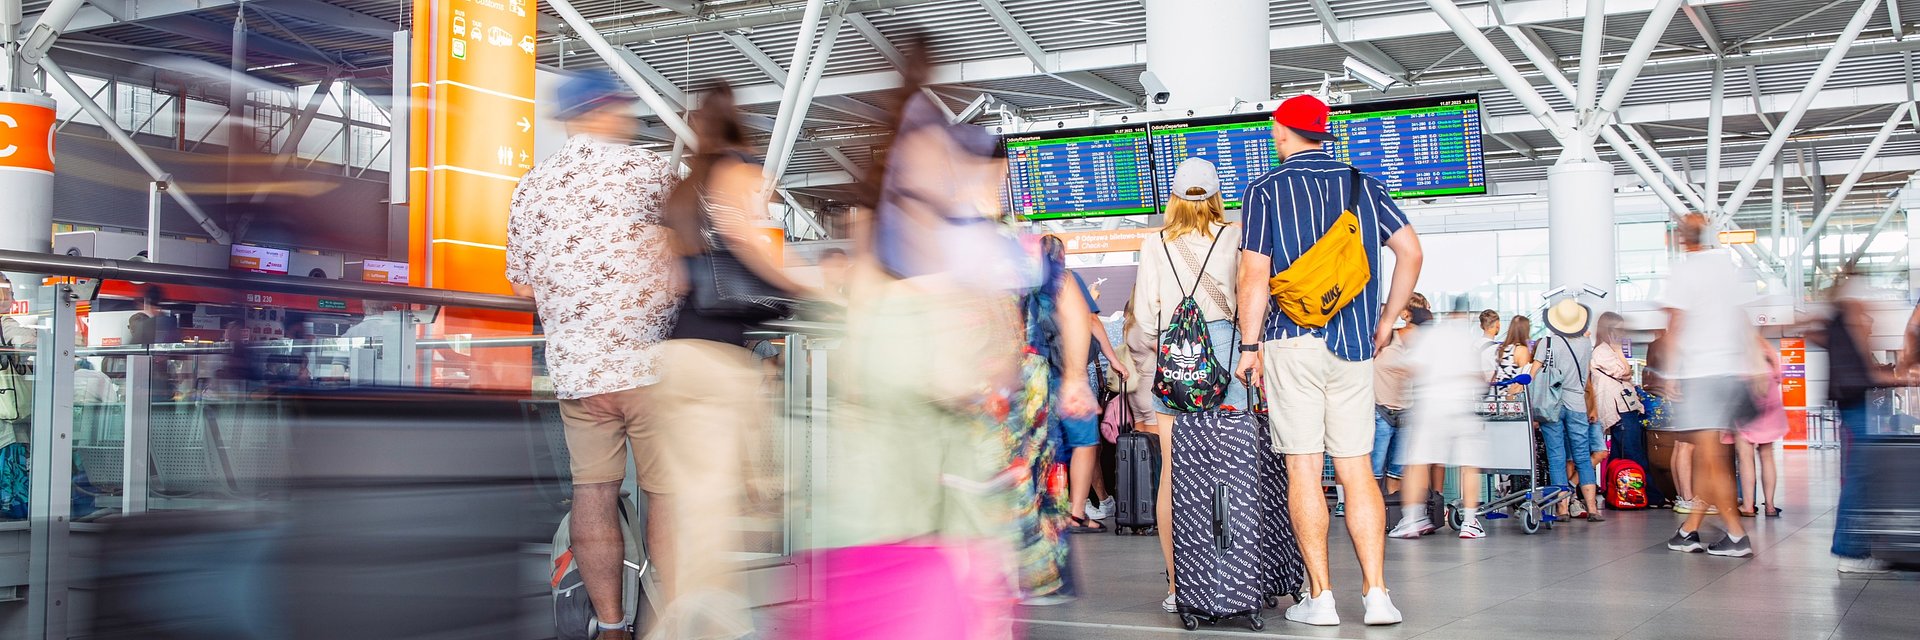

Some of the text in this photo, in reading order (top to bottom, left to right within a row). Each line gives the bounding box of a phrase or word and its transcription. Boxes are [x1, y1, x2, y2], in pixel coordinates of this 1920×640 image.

[1081, 234, 1109, 242] Odprawa
[1081, 242, 1109, 250] Check-in
[1320, 283, 1340, 307] NIKE
[1163, 369, 1207, 380] adidas
[1178, 428, 1196, 451] WINGS
[1189, 429, 1206, 450] WINGS
[1200, 430, 1217, 450] WINGS
[1220, 440, 1241, 453] WINGS
[1229, 435, 1250, 447] WINGS
[1180, 469, 1199, 489] WINGS
[1190, 467, 1209, 487] WINGS
[1230, 474, 1251, 489] WINGS
[1184, 509, 1202, 529] WINGS
[1192, 507, 1211, 526] WINGS
[1201, 504, 1212, 515] WIN
[1240, 511, 1258, 527] WINGS
[1175, 512, 1193, 531] WINGS
[1231, 516, 1250, 532] WINGS
[1174, 553, 1194, 572] WINGS
[1183, 551, 1204, 571] WINGS
[1193, 549, 1214, 569] WINGS
[1221, 559, 1242, 574] WINGS
[1232, 555, 1252, 569] WINGS
[1180, 589, 1198, 608] WINGS
[1190, 588, 1209, 610] WINGS
[1226, 597, 1247, 608] WINGS
[1236, 590, 1257, 602] WINGS
